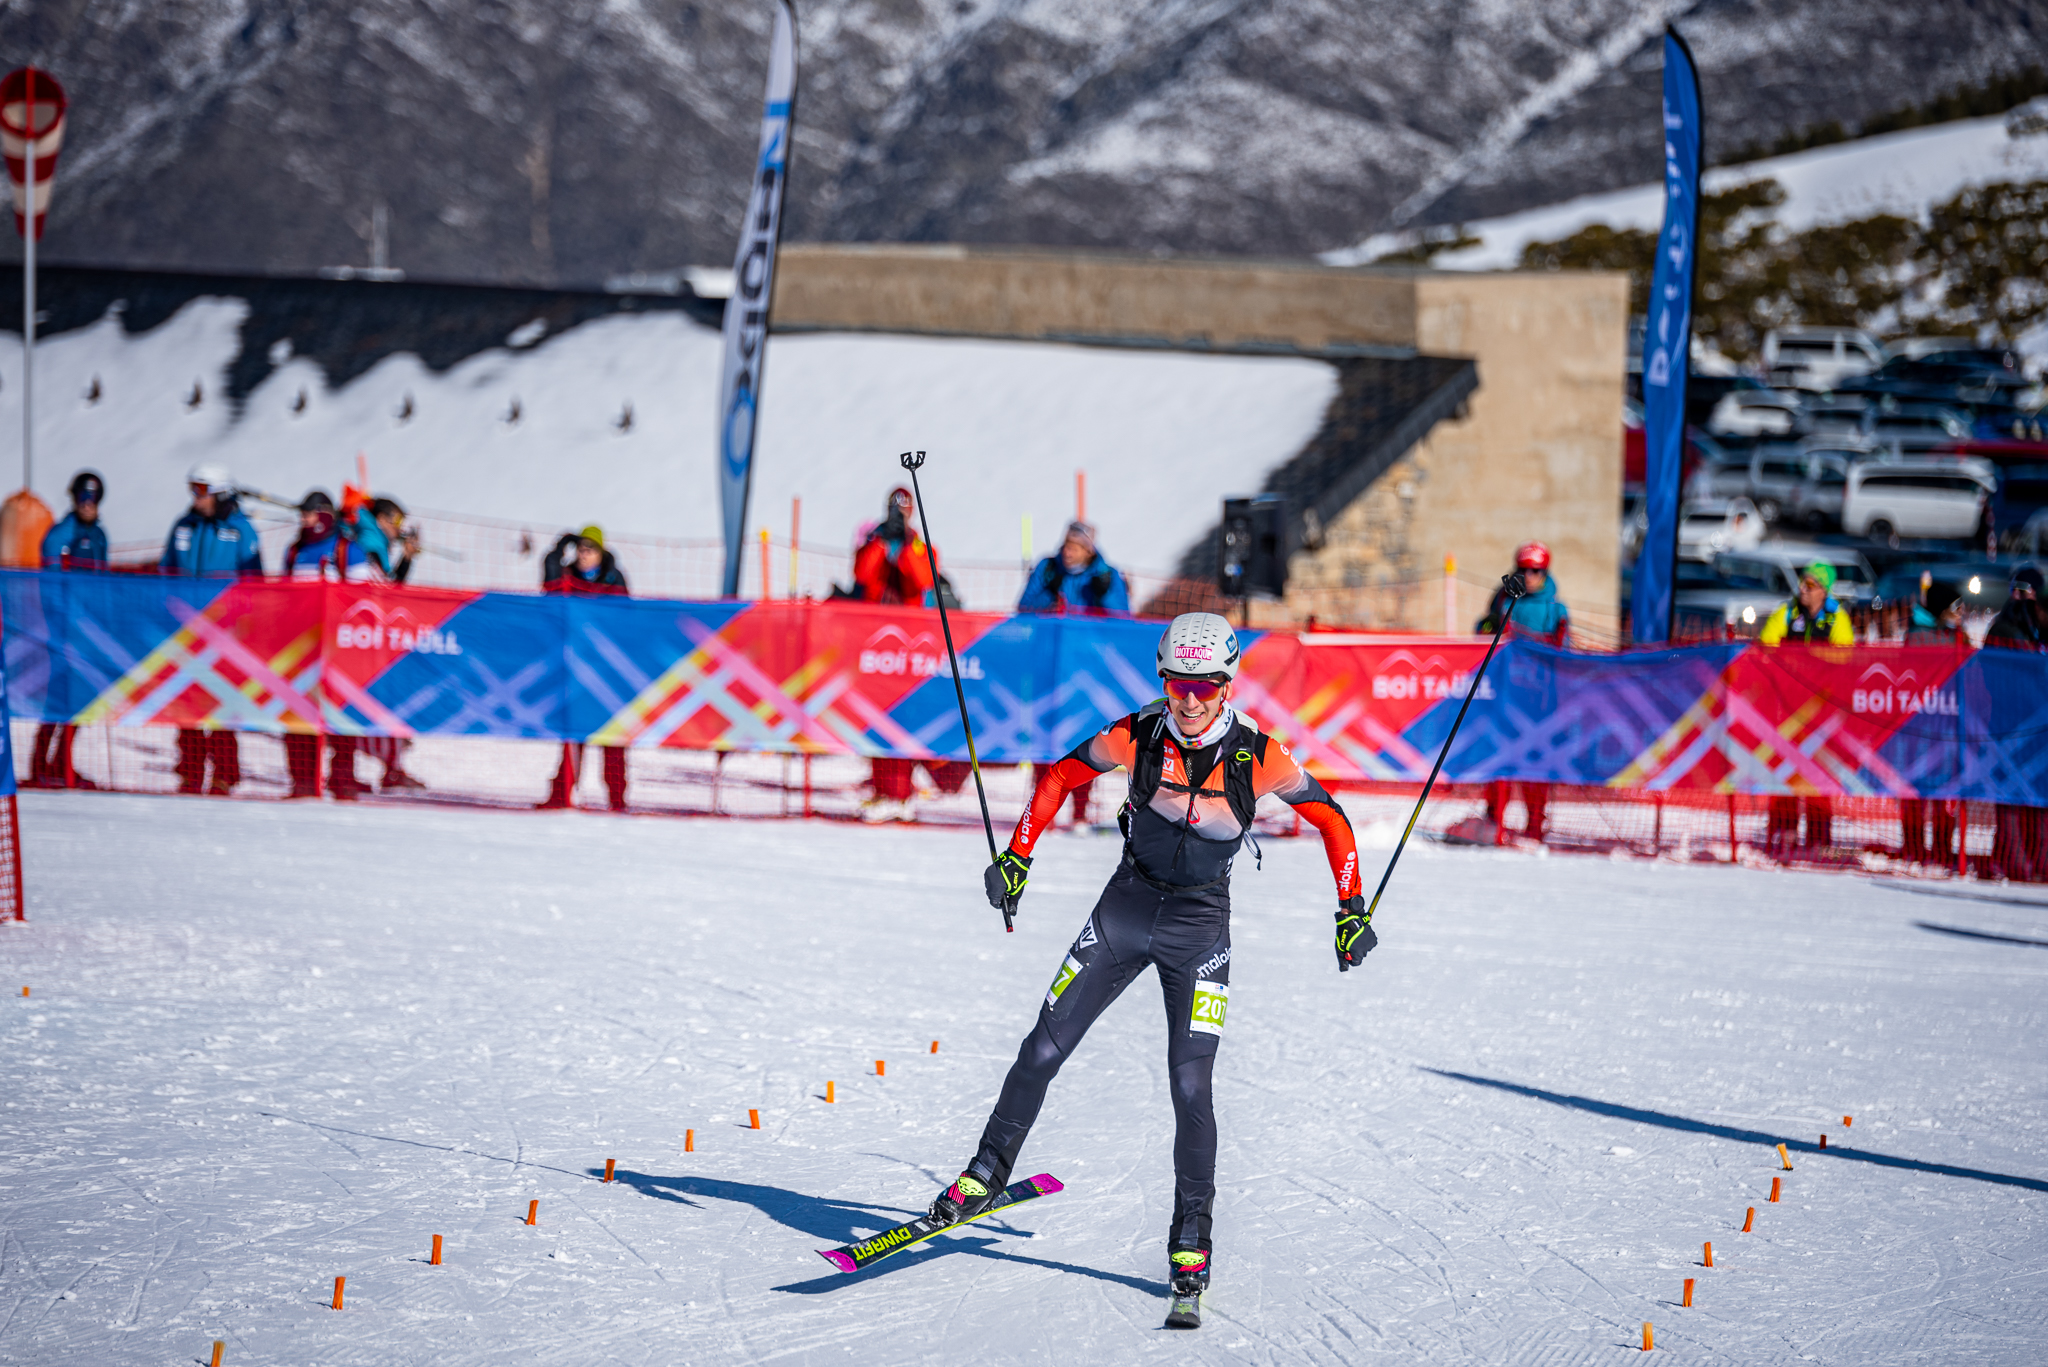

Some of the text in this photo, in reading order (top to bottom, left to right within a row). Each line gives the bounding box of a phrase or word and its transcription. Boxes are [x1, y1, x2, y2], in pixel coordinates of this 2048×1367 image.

[1852, 684, 1960, 716] BOÍ TAÜLL
[1339, 861, 1355, 892] aloja
[1196, 947, 1231, 978] maloj
[852, 1226, 913, 1261] DYNAFIT
